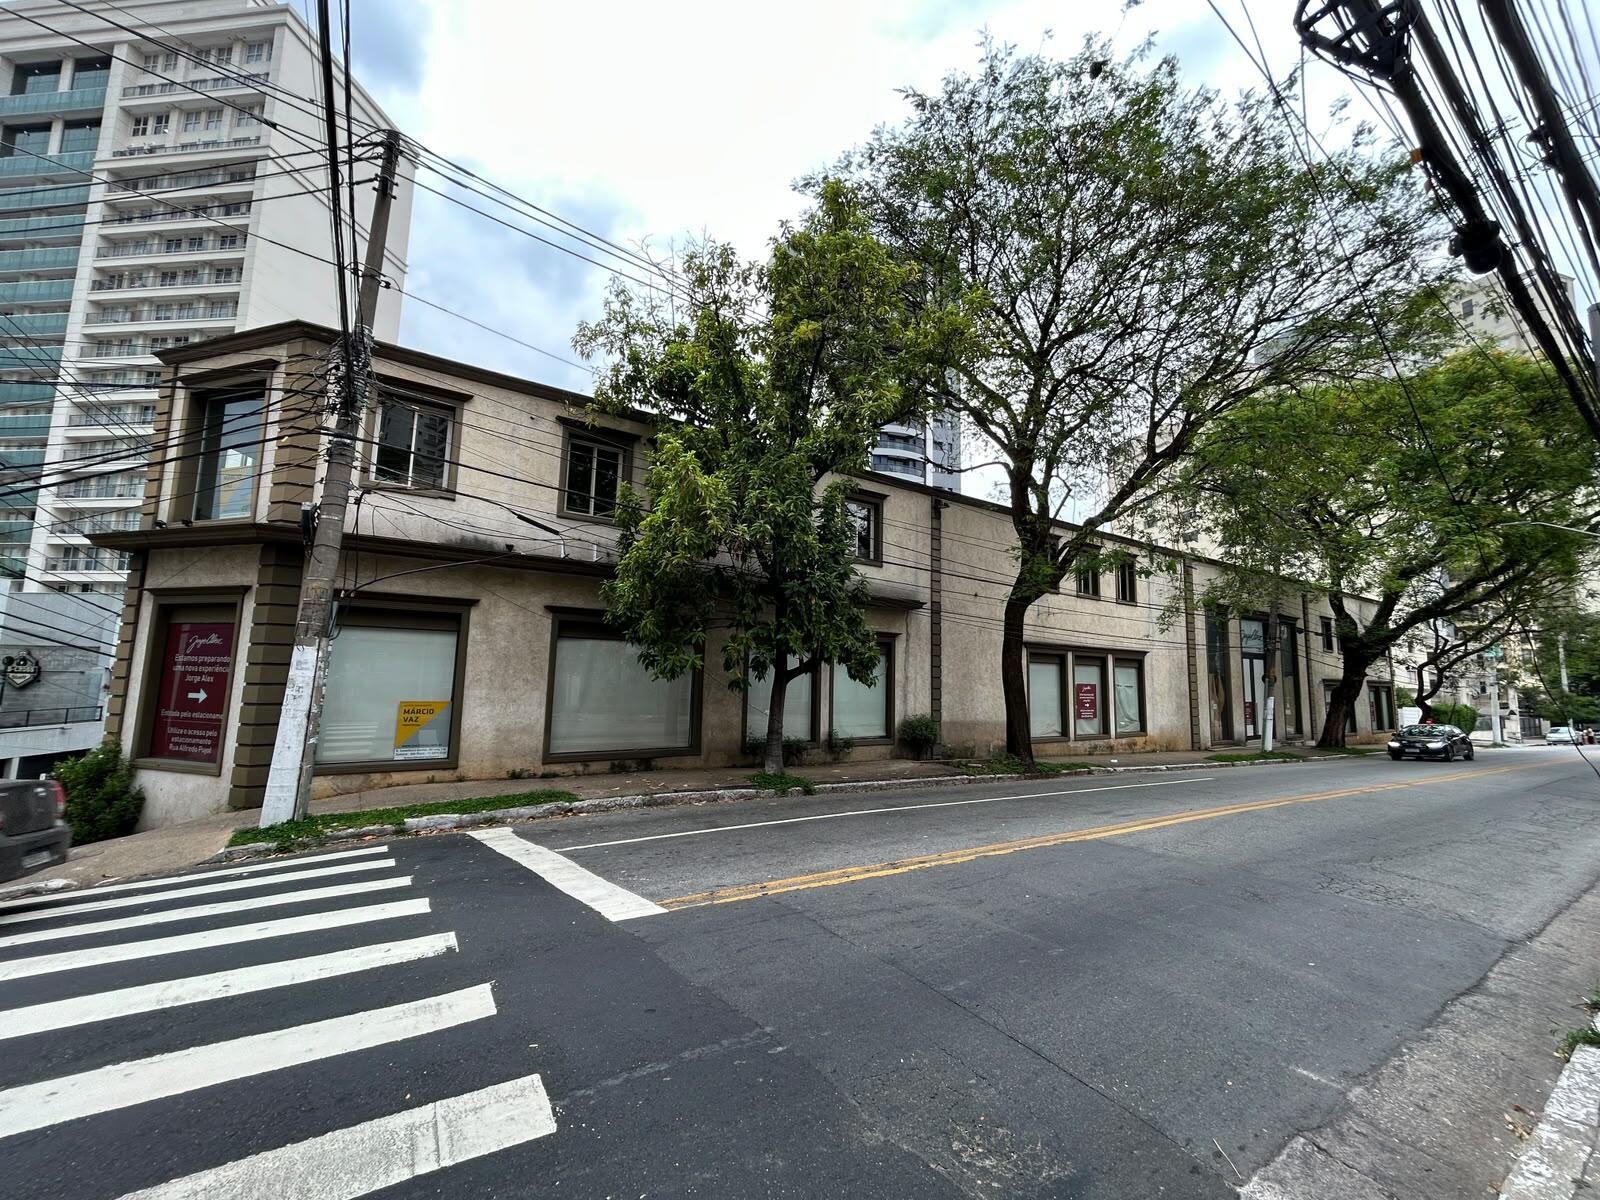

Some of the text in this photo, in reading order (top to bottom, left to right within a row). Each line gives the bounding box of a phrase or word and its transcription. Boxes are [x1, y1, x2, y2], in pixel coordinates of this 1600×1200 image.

[175, 653, 231, 664] Estamos preparando
[185, 674, 214, 684] Jorge Alex
[206, 729, 218, 737] pelo
[169, 743, 179, 751] Rua
